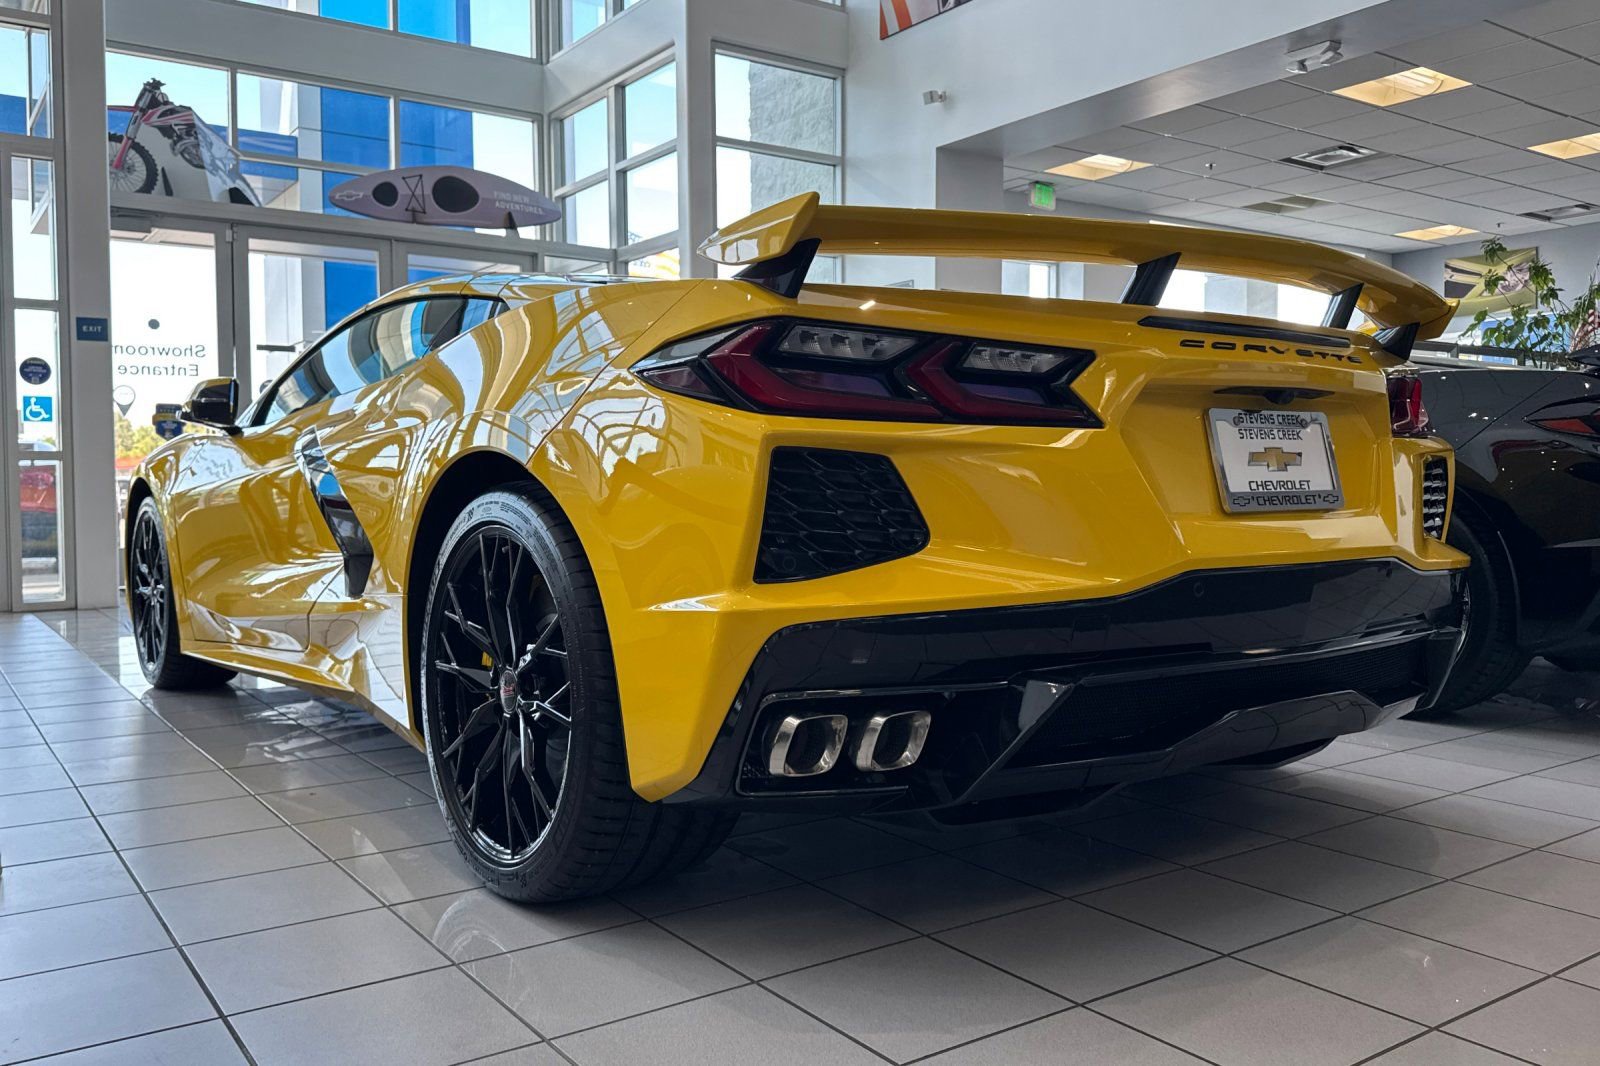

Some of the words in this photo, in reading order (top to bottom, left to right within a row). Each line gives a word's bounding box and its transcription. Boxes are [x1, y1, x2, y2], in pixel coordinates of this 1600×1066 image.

[82, 325, 102, 333] EXIT
[1179, 339, 1362, 364] CORVETTE
[1238, 412, 1275, 425] STEVENS
[1276, 414, 1302, 426] CREEK
[1238, 428, 1276, 440] STEVENS
[1276, 429, 1303, 441] CREEK
[1248, 480, 1311, 491] CHEVROLET
